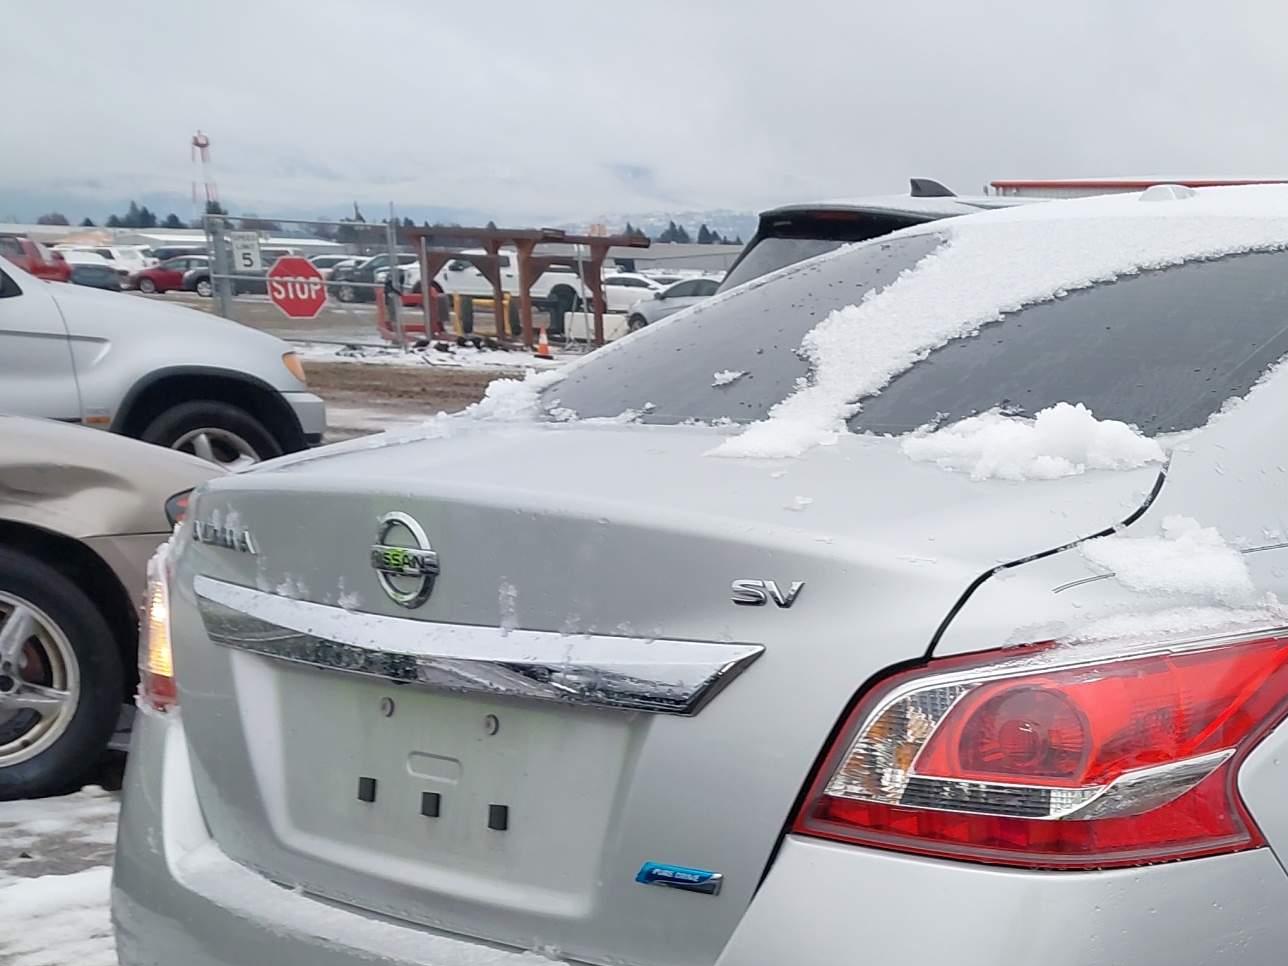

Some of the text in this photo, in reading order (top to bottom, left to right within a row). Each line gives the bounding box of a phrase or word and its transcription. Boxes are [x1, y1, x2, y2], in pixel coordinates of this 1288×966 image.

[242, 252, 254, 268] 5
[272, 276, 321, 299] STOP
[730, 579, 805, 608] SV
